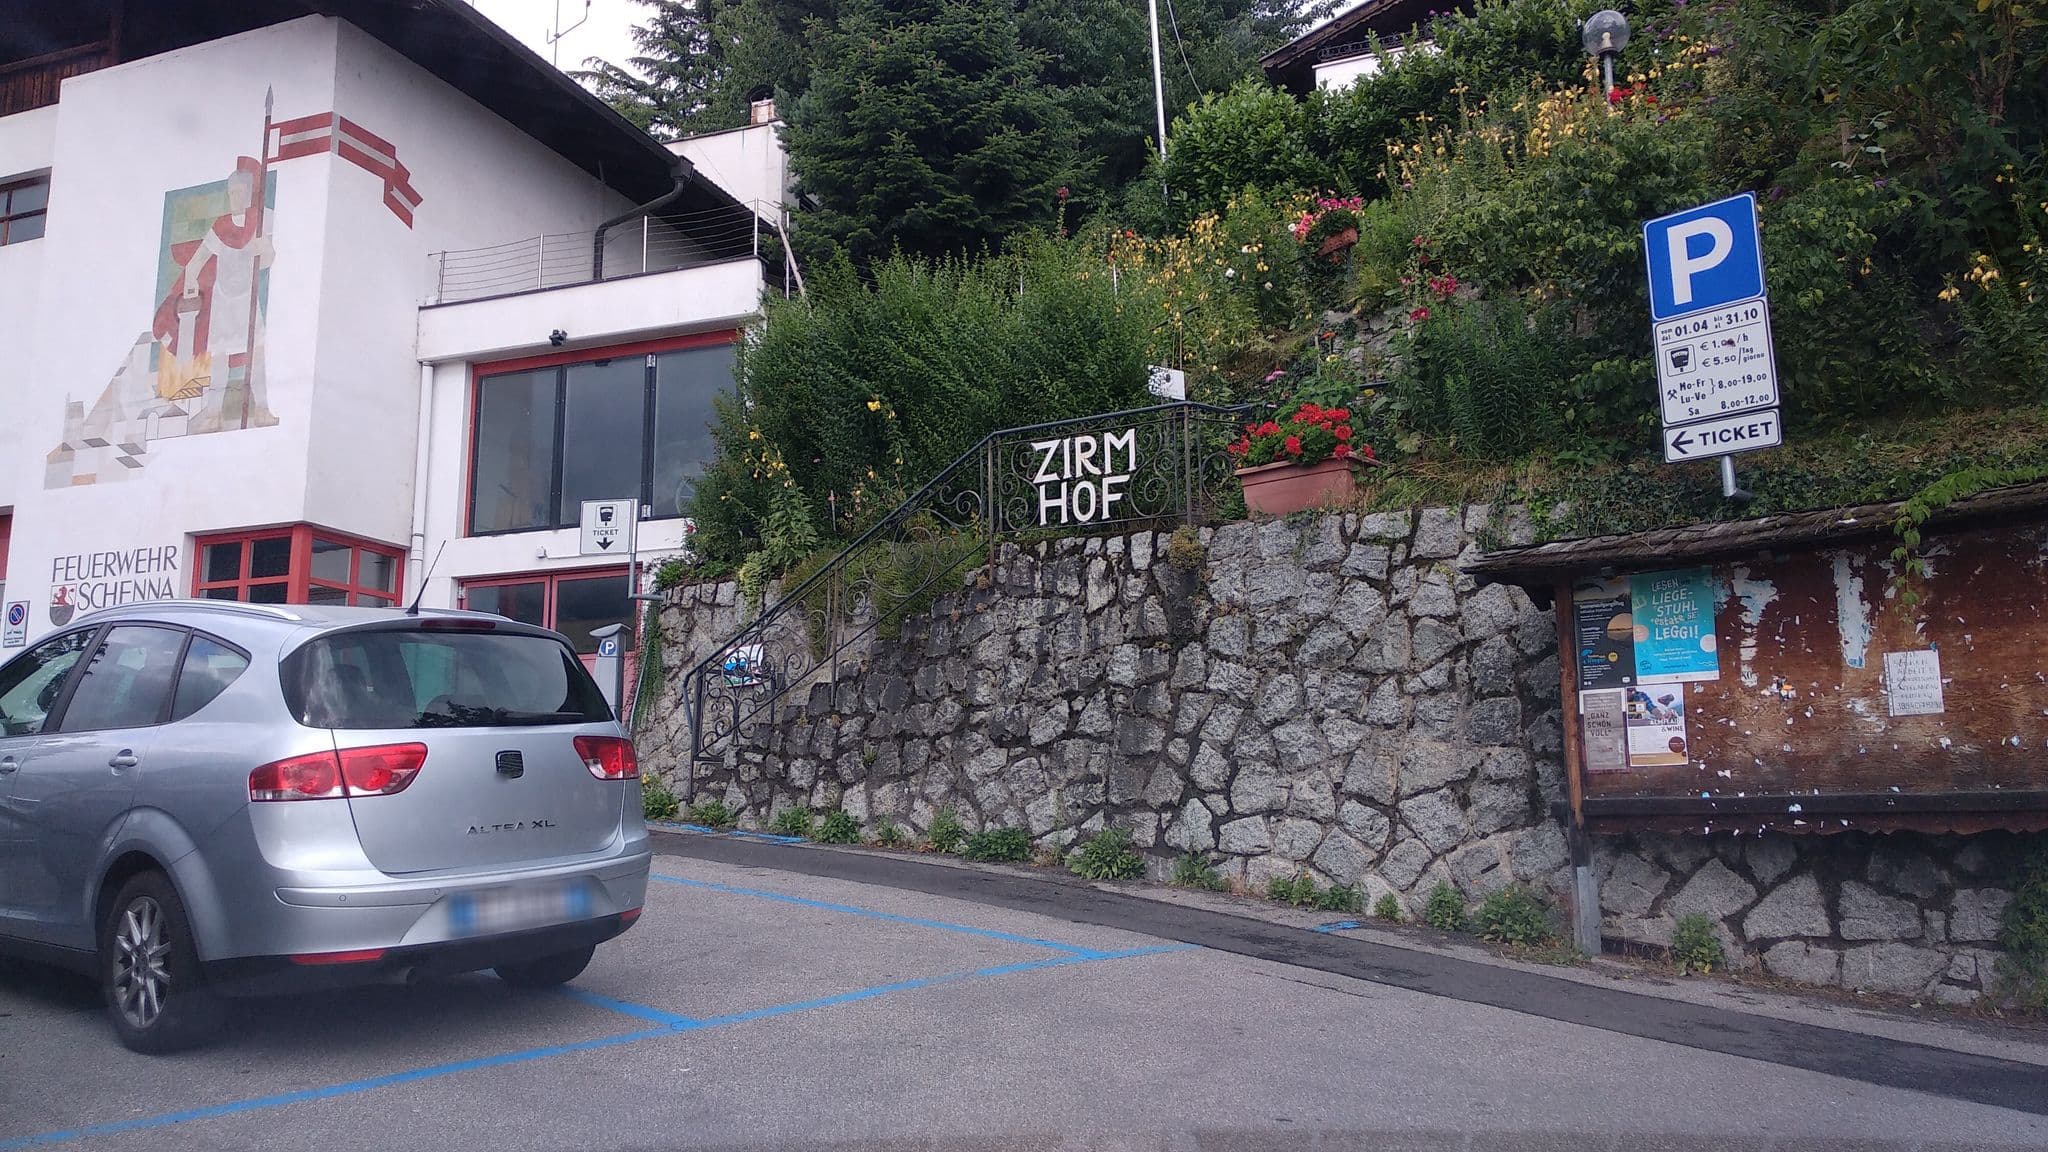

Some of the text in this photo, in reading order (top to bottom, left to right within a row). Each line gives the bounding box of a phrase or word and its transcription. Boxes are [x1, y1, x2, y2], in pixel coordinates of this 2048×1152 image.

[1667, 216, 1733, 306] P
[1675, 319, 1708, 337] 01.04
[1726, 307, 1758, 325] 31.10
[1712, 339, 1736, 349] 1.0
[1713, 354, 1737, 366] 5.50
[1680, 373, 1767, 391] Mo-Fr 8.00-19.00
[1681, 391, 1706, 404] Lu-Ve
[1688, 393, 1770, 416] Sa 8.00-12.00
[1699, 421, 1773, 446] TICKET
[1031, 428, 1137, 484] ZIRM
[1039, 474, 1130, 526] HOF
[593, 528, 619, 537] TICKET
[51, 545, 178, 583] FEUERWEHR
[77, 576, 174, 611] SCHENNA
[1651, 577, 1679, 592] LESEN
[1652, 588, 1693, 605] LIEGE-
[1656, 599, 1698, 617] STUHL
[1655, 625, 1698, 640] LEGGI!
[605, 641, 614, 655] P
[466, 820, 556, 836] ALTEA XL
